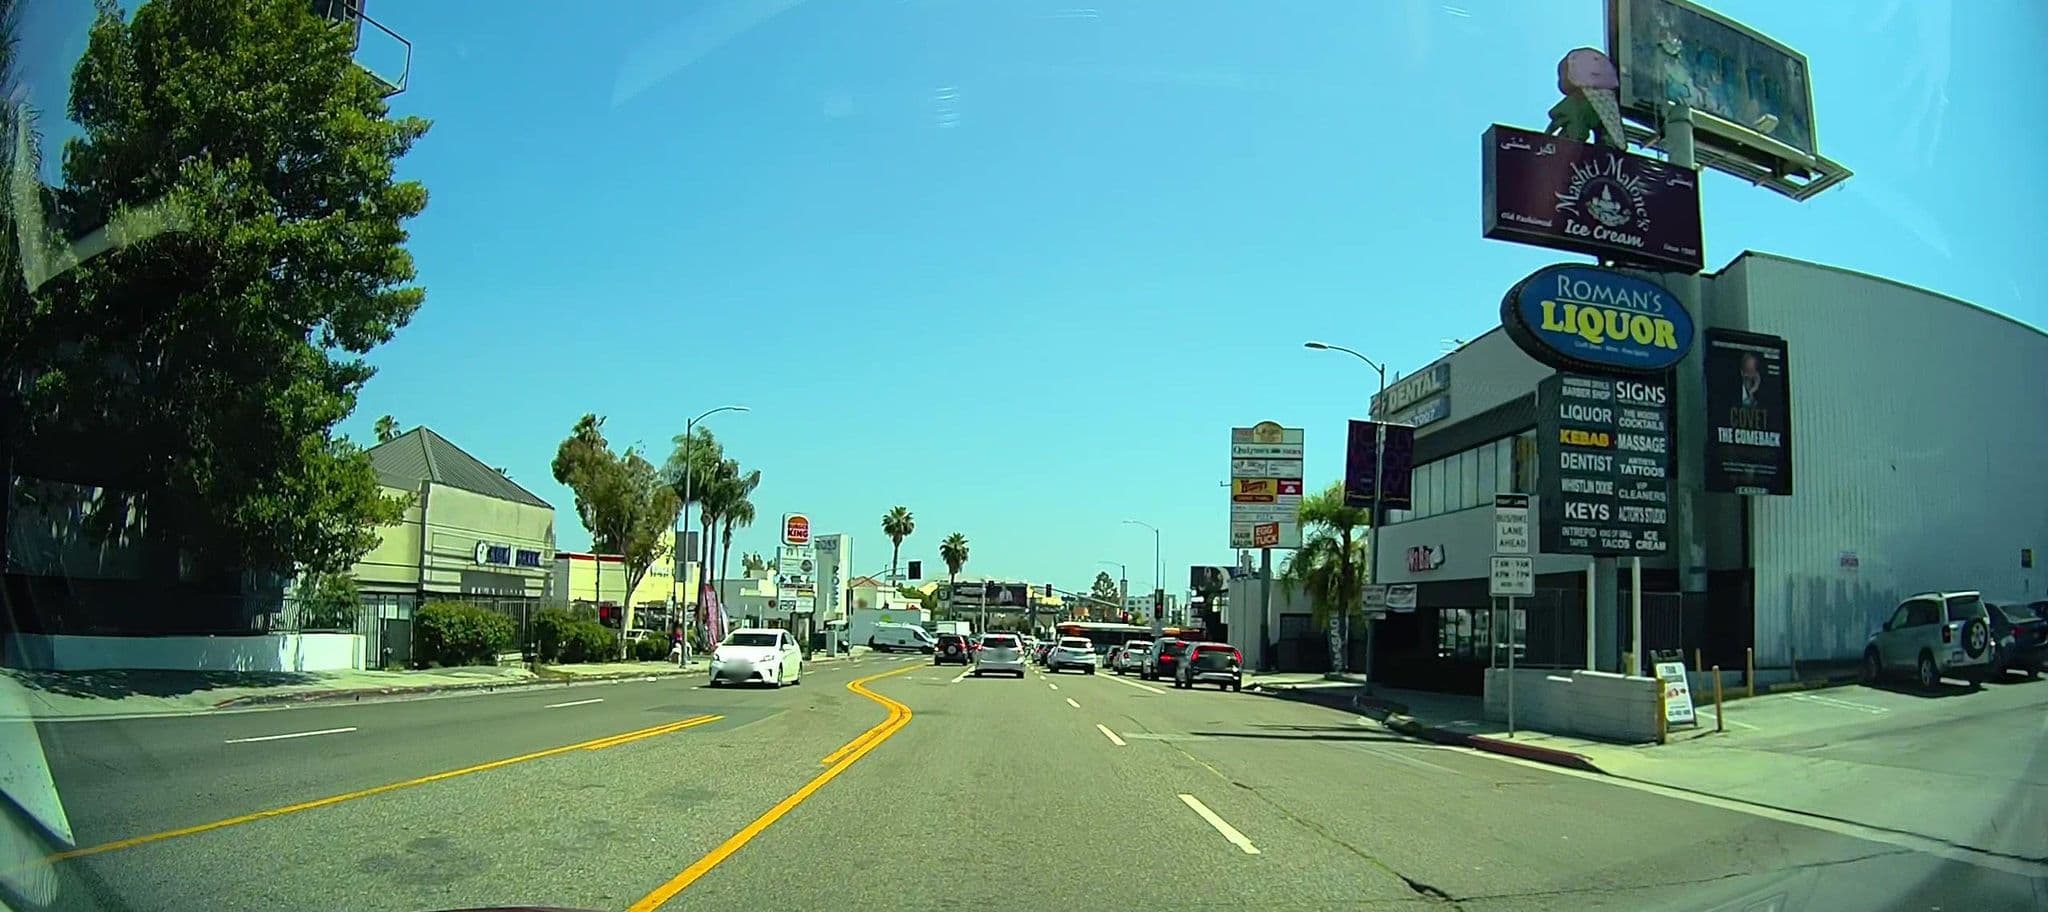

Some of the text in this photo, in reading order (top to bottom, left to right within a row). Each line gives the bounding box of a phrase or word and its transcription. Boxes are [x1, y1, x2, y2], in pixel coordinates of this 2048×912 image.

[1554, 158, 1600, 217] Mashti
[1565, 219, 1644, 248] Ice Cream
[1558, 274, 1662, 312] ROMAN'S
[1540, 300, 1678, 350] LIQUOR
[1390, 370, 1441, 407] DENTAL
[1616, 381, 1666, 404] SIGNS
[1560, 404, 1612, 424] LIQUOR
[1730, 406, 1768, 430] COVET
[1619, 418, 1664, 432] COCKTAILS
[1560, 429, 1610, 448] KEBAB
[1618, 434, 1666, 454] MASSAGE
[1718, 427, 1780, 447] THE COMEBACK
[1561, 452, 1613, 472] DENTIST
[1619, 464, 1665, 478] TATTOOS
[1619, 489, 1666, 502] CLEANERS
[1565, 502, 1610, 520] KEYS
[788, 530, 808, 538] KING
[1256, 526, 1273, 536] EGG
[1502, 526, 1522, 535] LANE
[1644, 530, 1658, 540] ICE
[1256, 535, 1278, 546] TUCK
[1500, 538, 1526, 548] AHEAD
[1601, 539, 1630, 550] TACOS
[1636, 540, 1666, 550] CREAM
